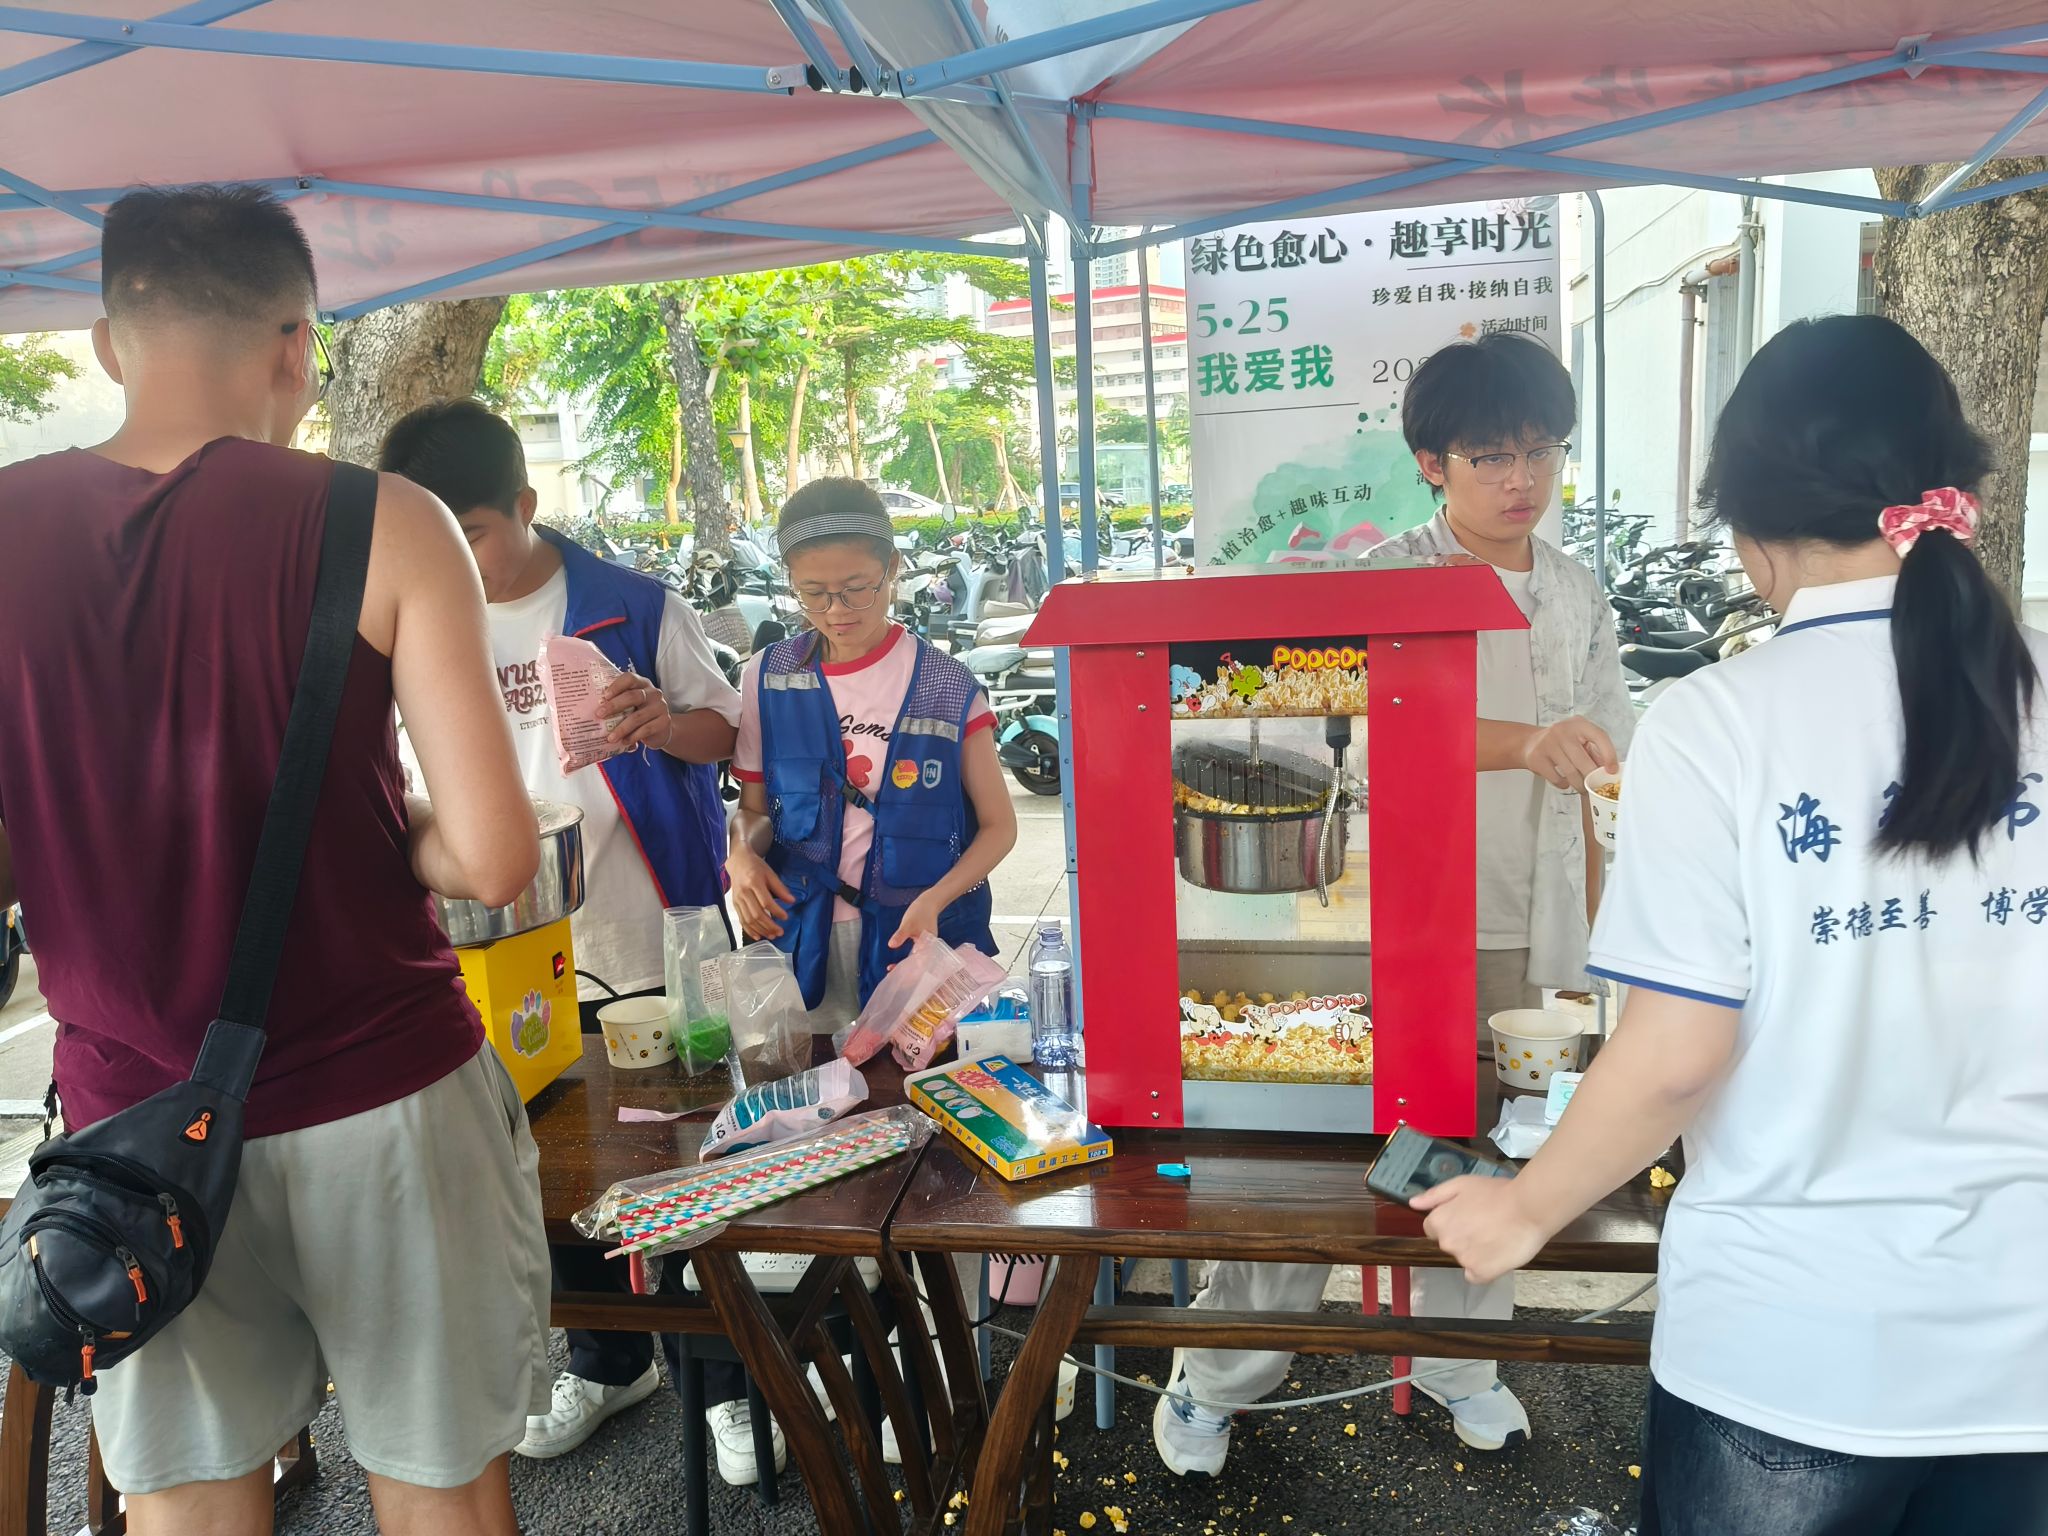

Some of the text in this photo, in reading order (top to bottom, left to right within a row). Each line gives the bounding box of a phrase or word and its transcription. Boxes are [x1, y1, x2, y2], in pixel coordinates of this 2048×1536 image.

[1481, 315, 1548, 335] 活动时间
[1197, 344, 1335, 397] 我爱我
[1373, 356, 1431, 383] 20
[1811, 889, 1938, 945] 崇德至善
[1268, 993, 1367, 1016] POPCORN
